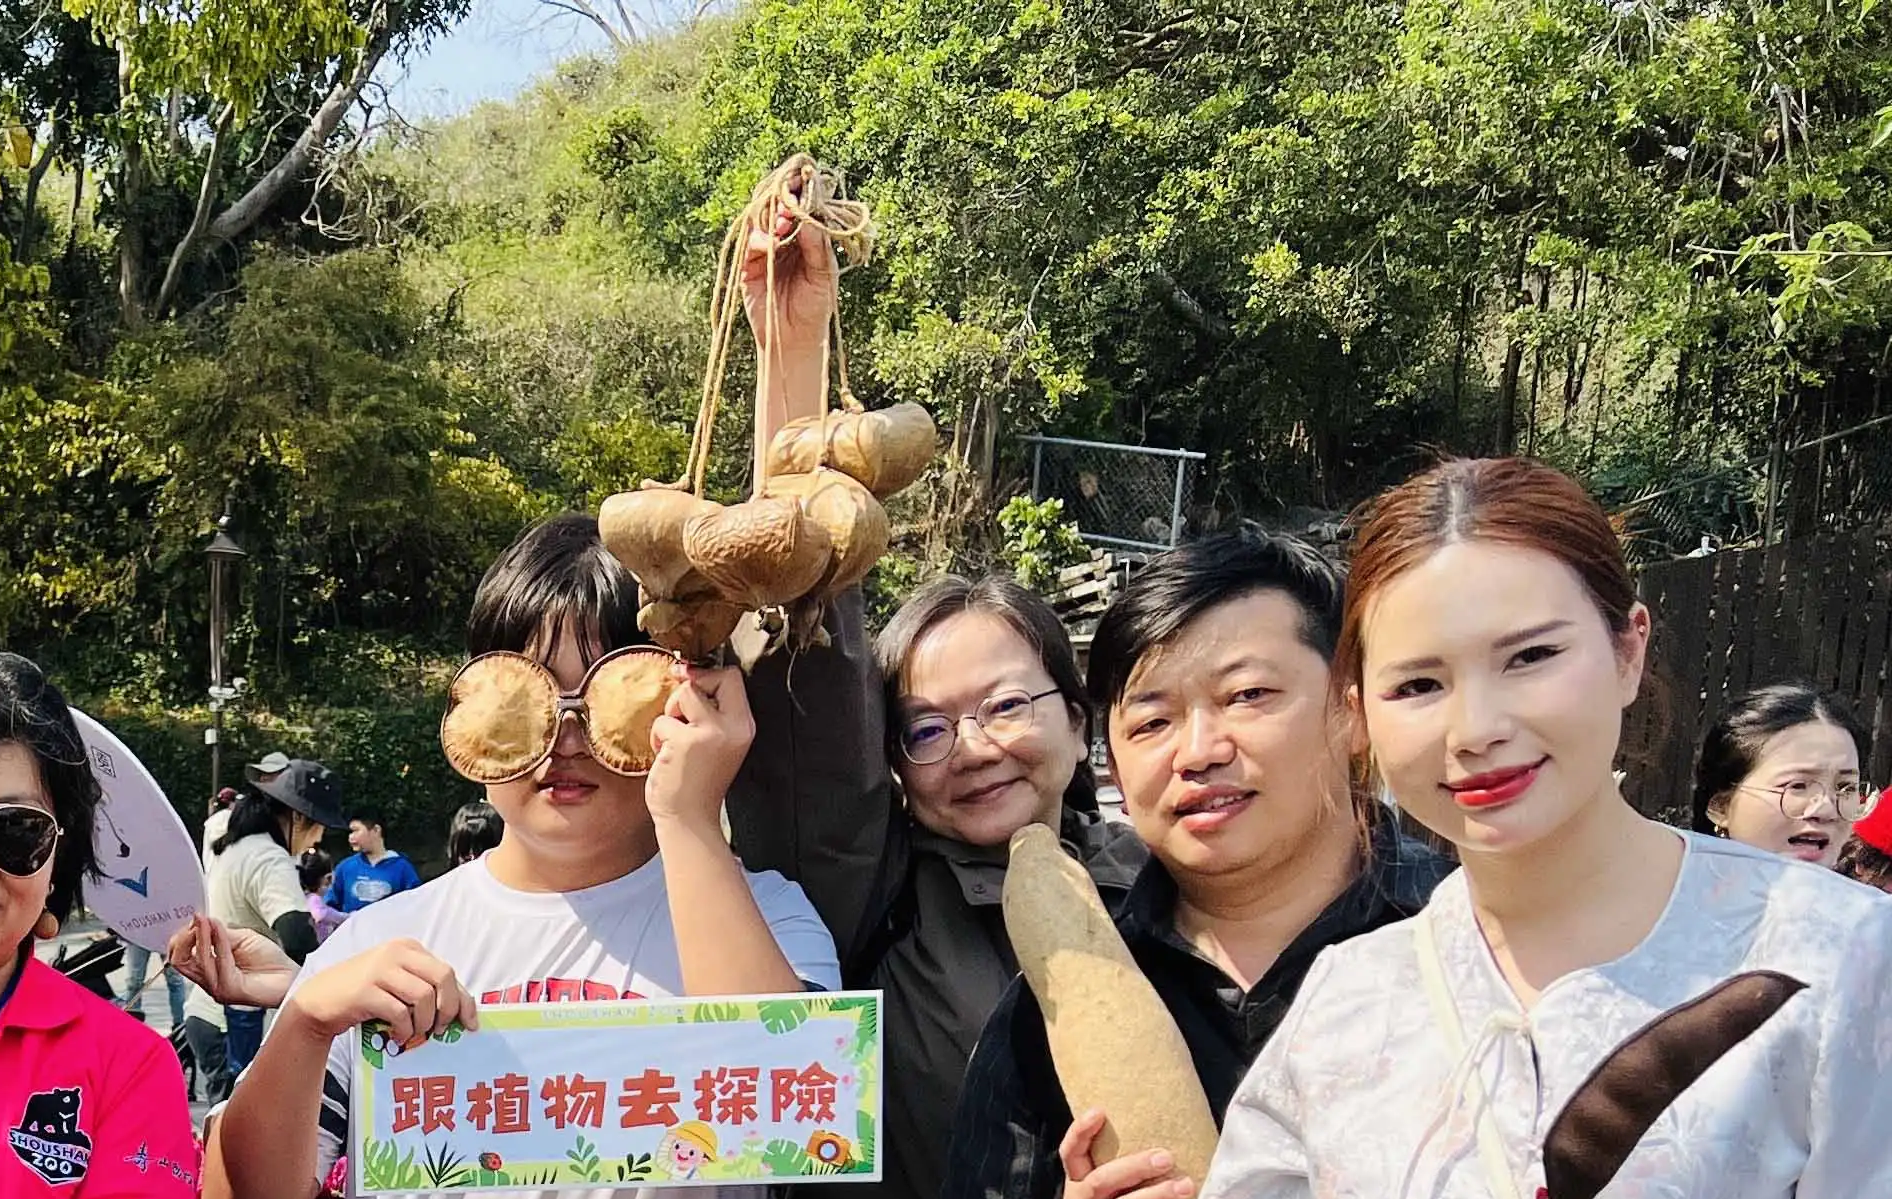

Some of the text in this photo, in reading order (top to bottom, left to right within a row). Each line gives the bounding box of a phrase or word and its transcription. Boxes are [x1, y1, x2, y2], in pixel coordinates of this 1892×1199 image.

[119, 903, 196, 932] SHOUSHAN ZOO
[392, 1061, 839, 1135] 跟植物去探險
[31, 1152, 72, 1175] ZOO
